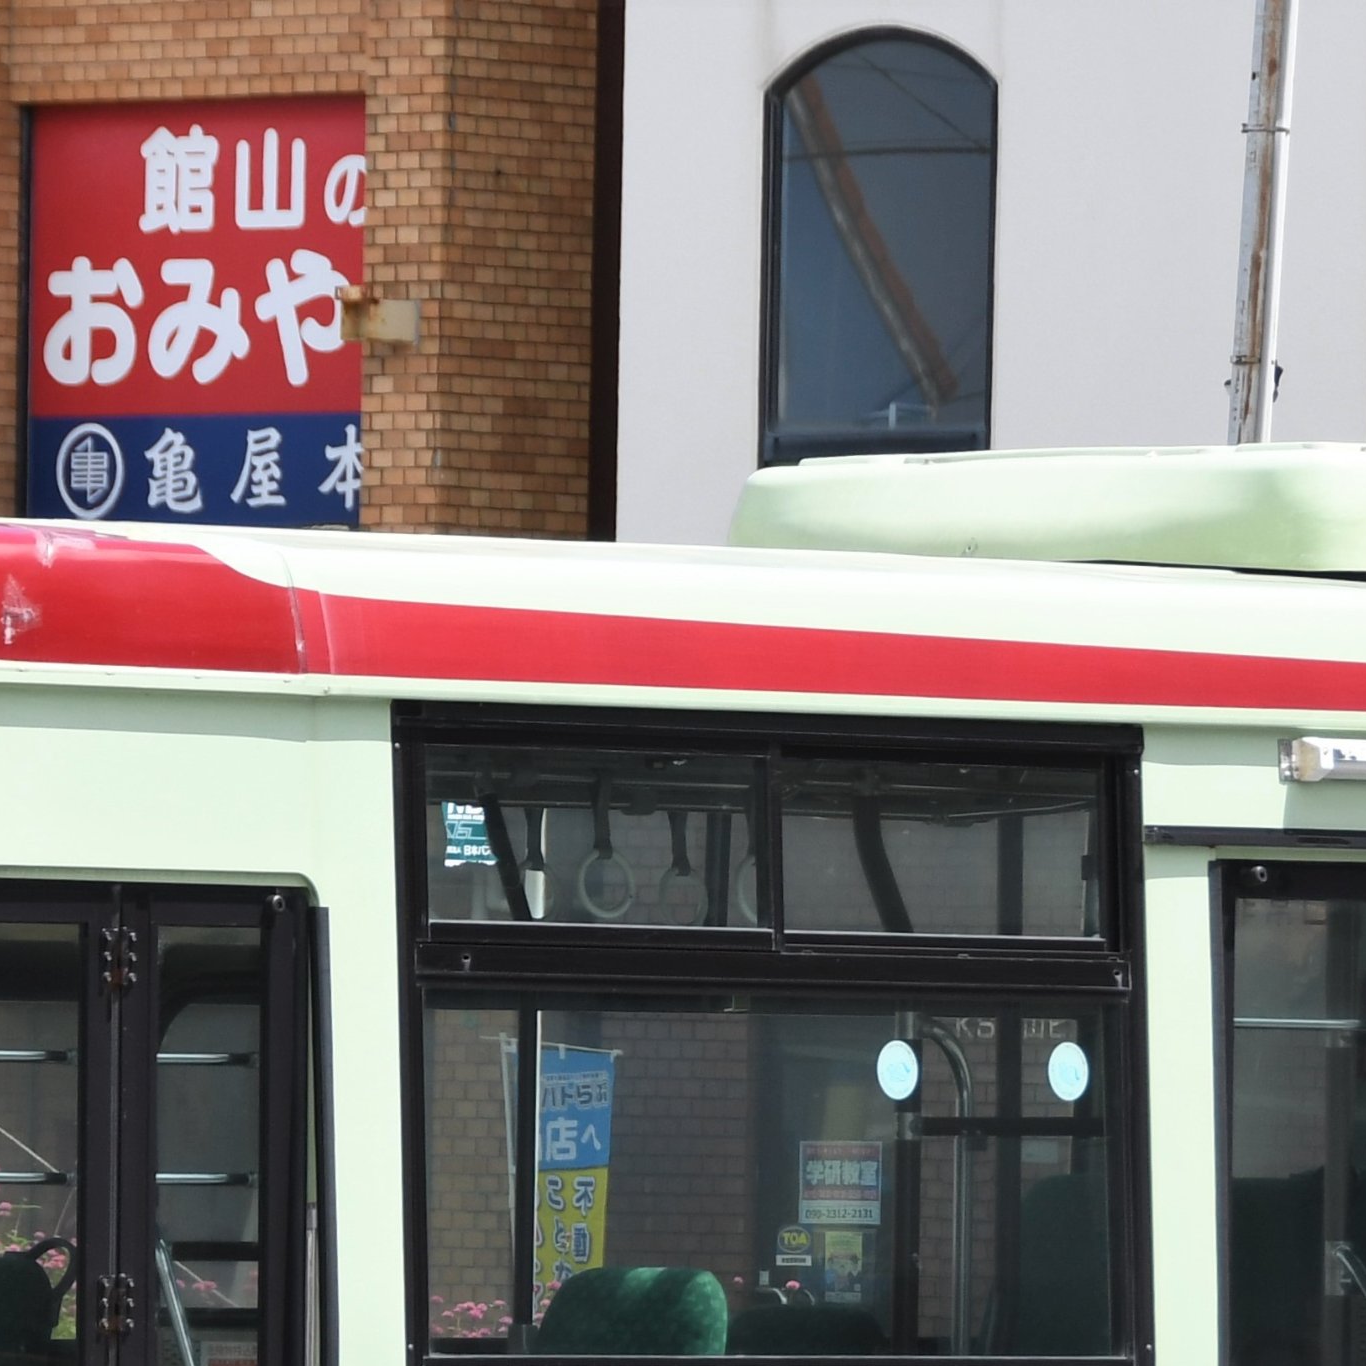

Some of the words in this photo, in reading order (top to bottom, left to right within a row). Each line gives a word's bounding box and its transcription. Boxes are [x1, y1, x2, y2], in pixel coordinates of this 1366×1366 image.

[139, 124, 366, 234] 館山の
[43, 248, 349, 386] おみや
[144, 424, 364, 514] 亀屋本
[783, 1232, 808, 1245] TOA
